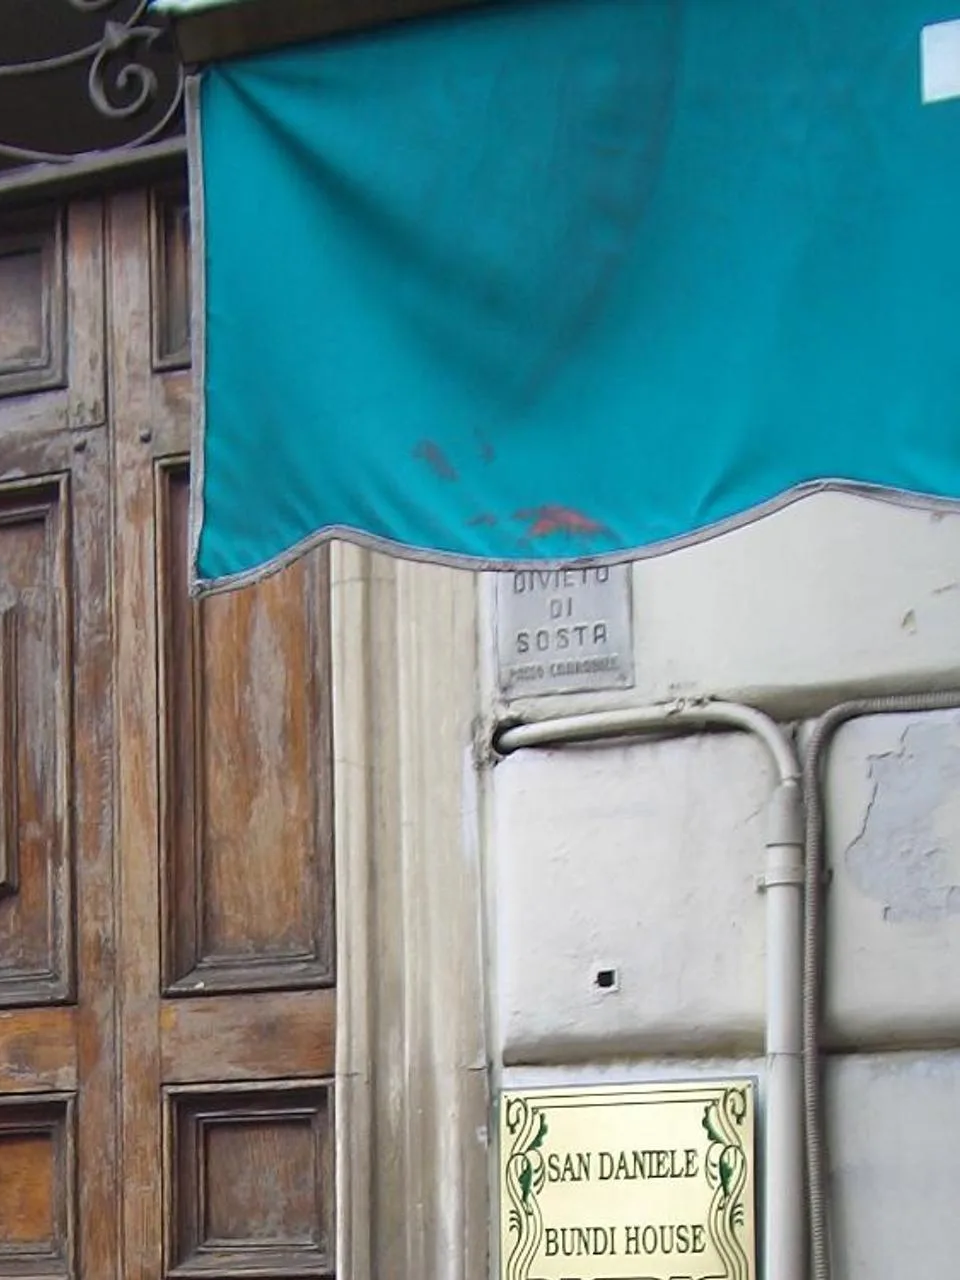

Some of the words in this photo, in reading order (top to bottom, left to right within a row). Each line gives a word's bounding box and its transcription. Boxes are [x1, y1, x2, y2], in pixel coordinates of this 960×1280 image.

[514, 566, 609, 594] DIVIETO
[550, 597, 572, 619] DI
[517, 623, 608, 653] SOSTA
[547, 1152, 591, 1182] SAN
[598, 1149, 699, 1180] DANIELE
[544, 1226, 616, 1257] BUNDI
[624, 1224, 706, 1255] HOUSE
